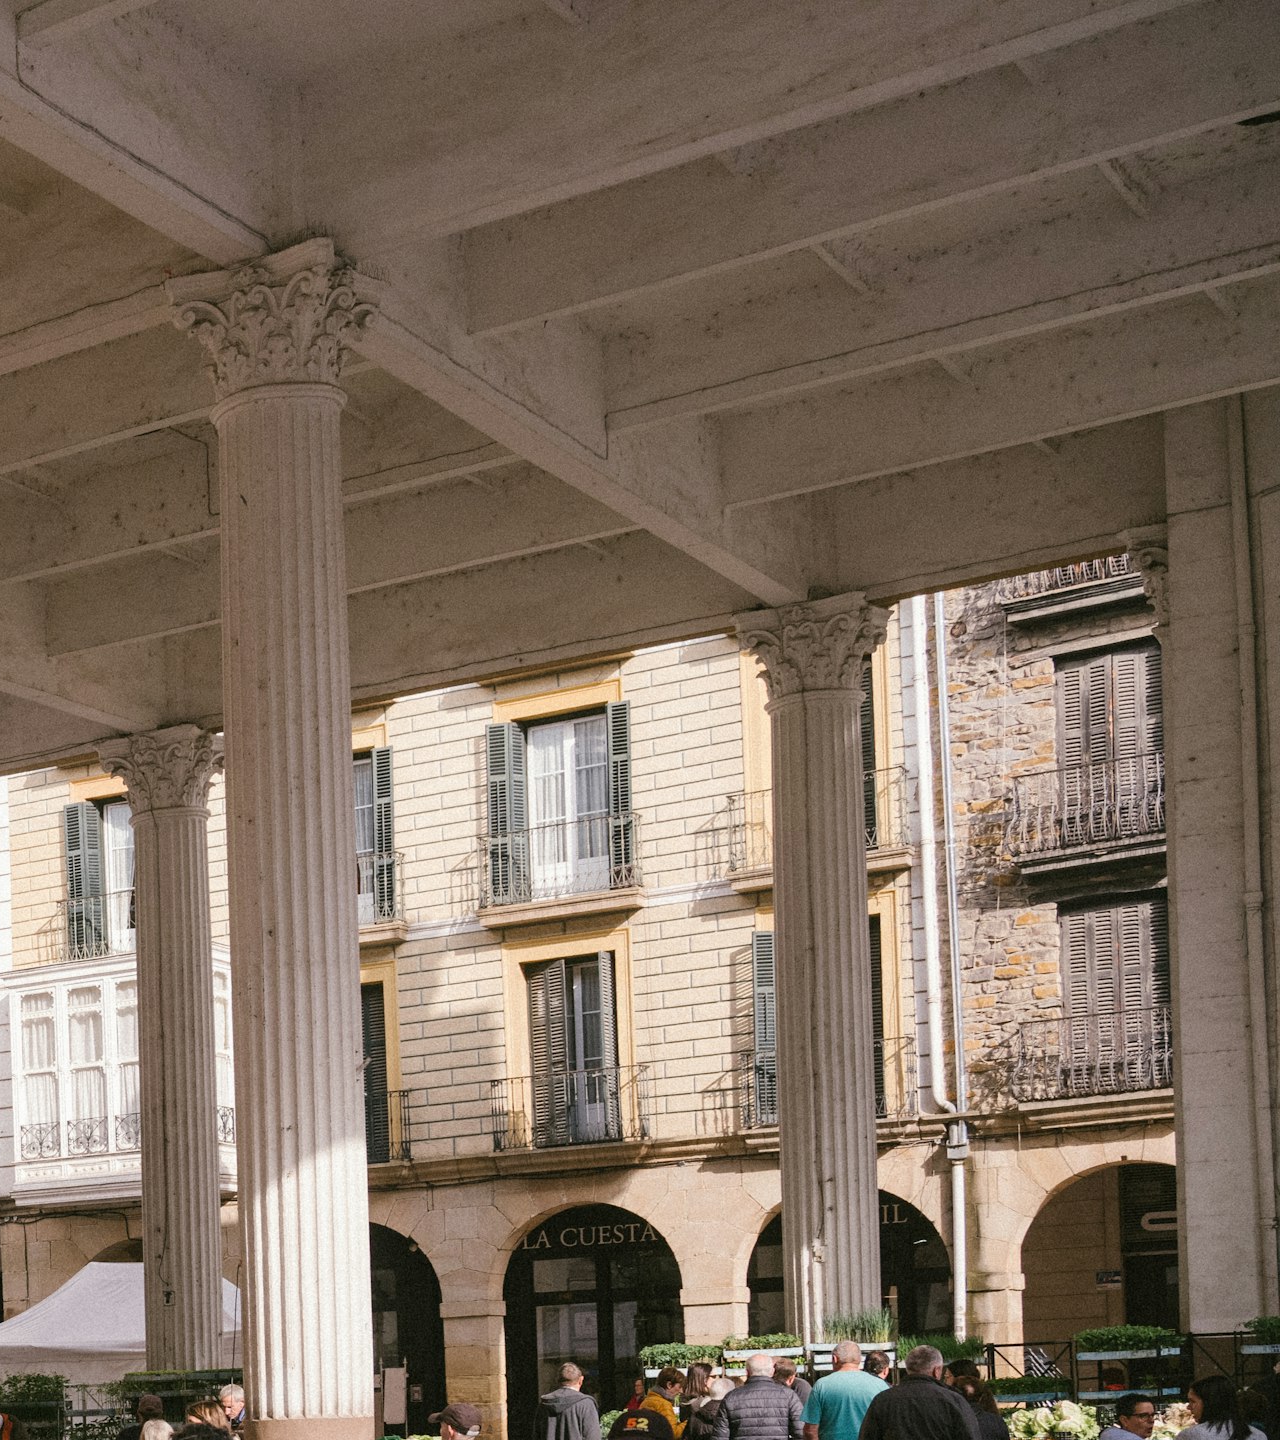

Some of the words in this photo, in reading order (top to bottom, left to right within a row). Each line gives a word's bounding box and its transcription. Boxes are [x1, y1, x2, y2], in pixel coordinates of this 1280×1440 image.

[522, 1231, 552, 1250] LA
[559, 1223, 658, 1247] CUESTA
[627, 1417, 649, 1429] 52
